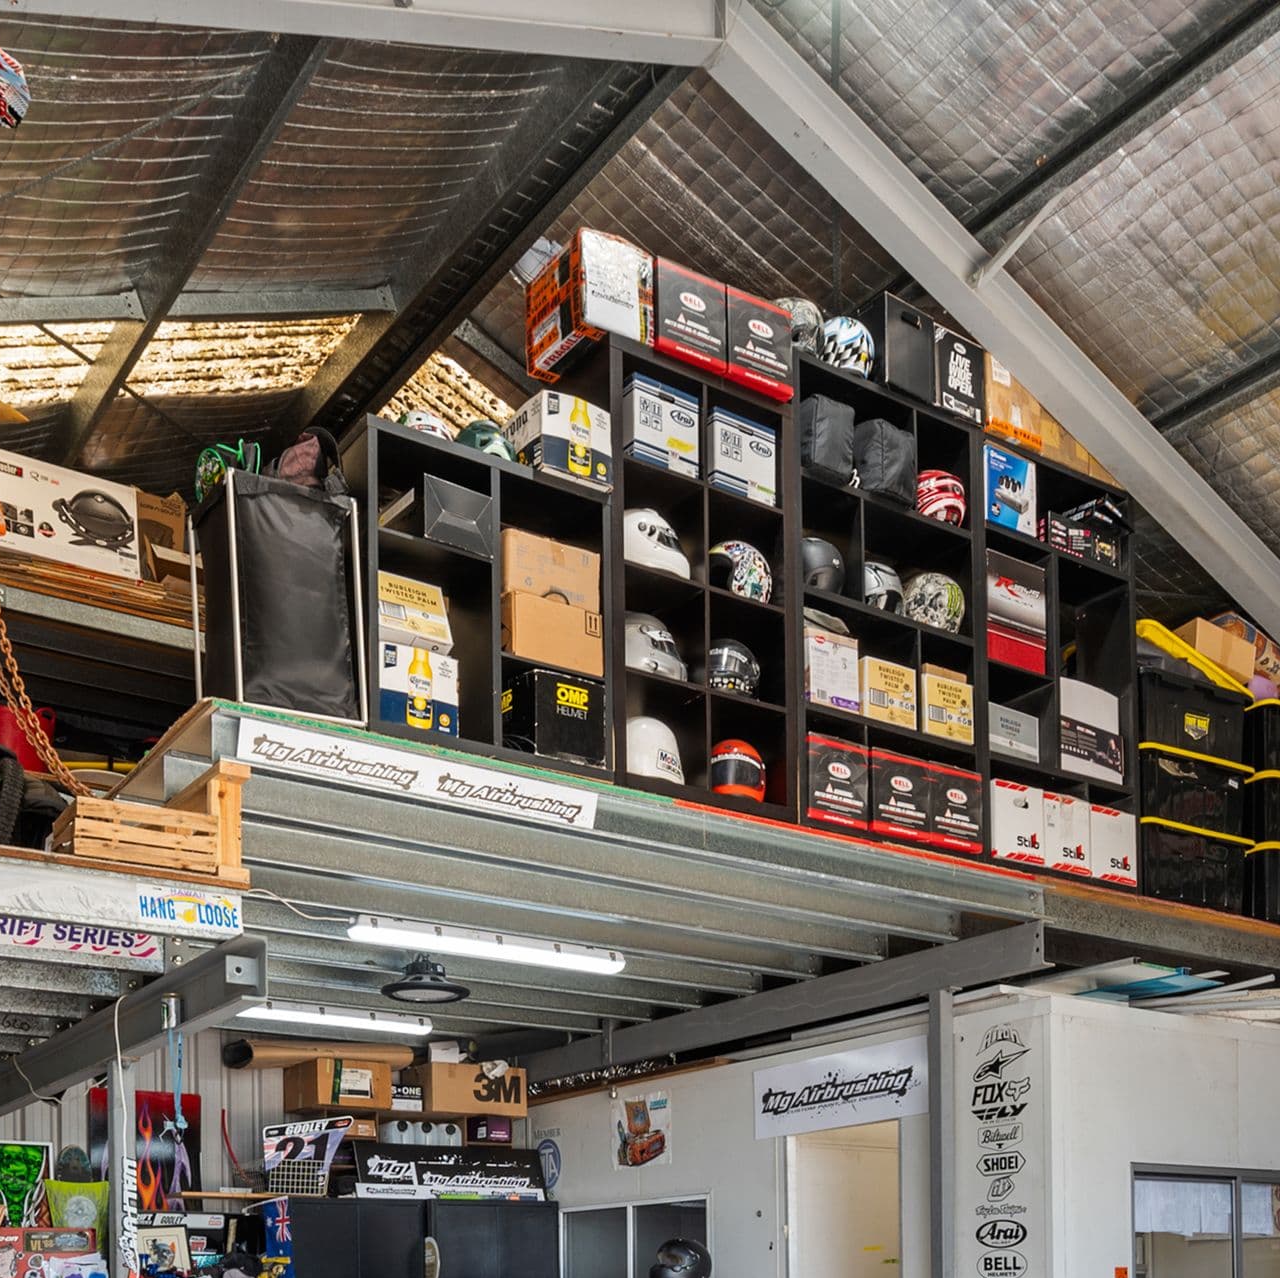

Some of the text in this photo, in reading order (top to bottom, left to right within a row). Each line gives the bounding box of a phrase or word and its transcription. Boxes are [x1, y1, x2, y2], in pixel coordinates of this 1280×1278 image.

[950, 350, 972, 371] LIVE
[949, 363, 972, 385] WIDE
[672, 410, 694, 427] Arai
[751, 442, 772, 456] Arai
[388, 581, 428, 597] BURLEIGH
[414, 594, 438, 607] PALM
[556, 687, 589, 705] OMP
[556, 705, 588, 721] HELMET
[295, 746, 416, 786] Airbrushing
[830, 764, 849, 776] BELL
[893, 778, 911, 790] BELL
[474, 783, 580, 819] Airbrushing
[949, 791, 965, 803] BELL
[1017, 833, 1040, 850] Stilo
[1062, 844, 1085, 861] Stilo
[1110, 855, 1131, 872] Stilo
[139, 895, 240, 929] HANG LOOSE
[52, 921, 137, 949] SERIES
[473, 1073, 521, 1104] 3M
[797, 1072, 908, 1107] Airbrushing
[971, 1080, 1009, 1106] FOX
[285, 1120, 328, 1136] GOOLEY
[981, 1126, 1020, 1144] Biltwell
[983, 1155, 1019, 1172] SHOEI
[449, 1175, 529, 1189] Airbrushing
[160, 1215, 184, 1226] GOOLEY
[980, 1223, 1021, 1241] Arai
[983, 1256, 1022, 1271] BELL
